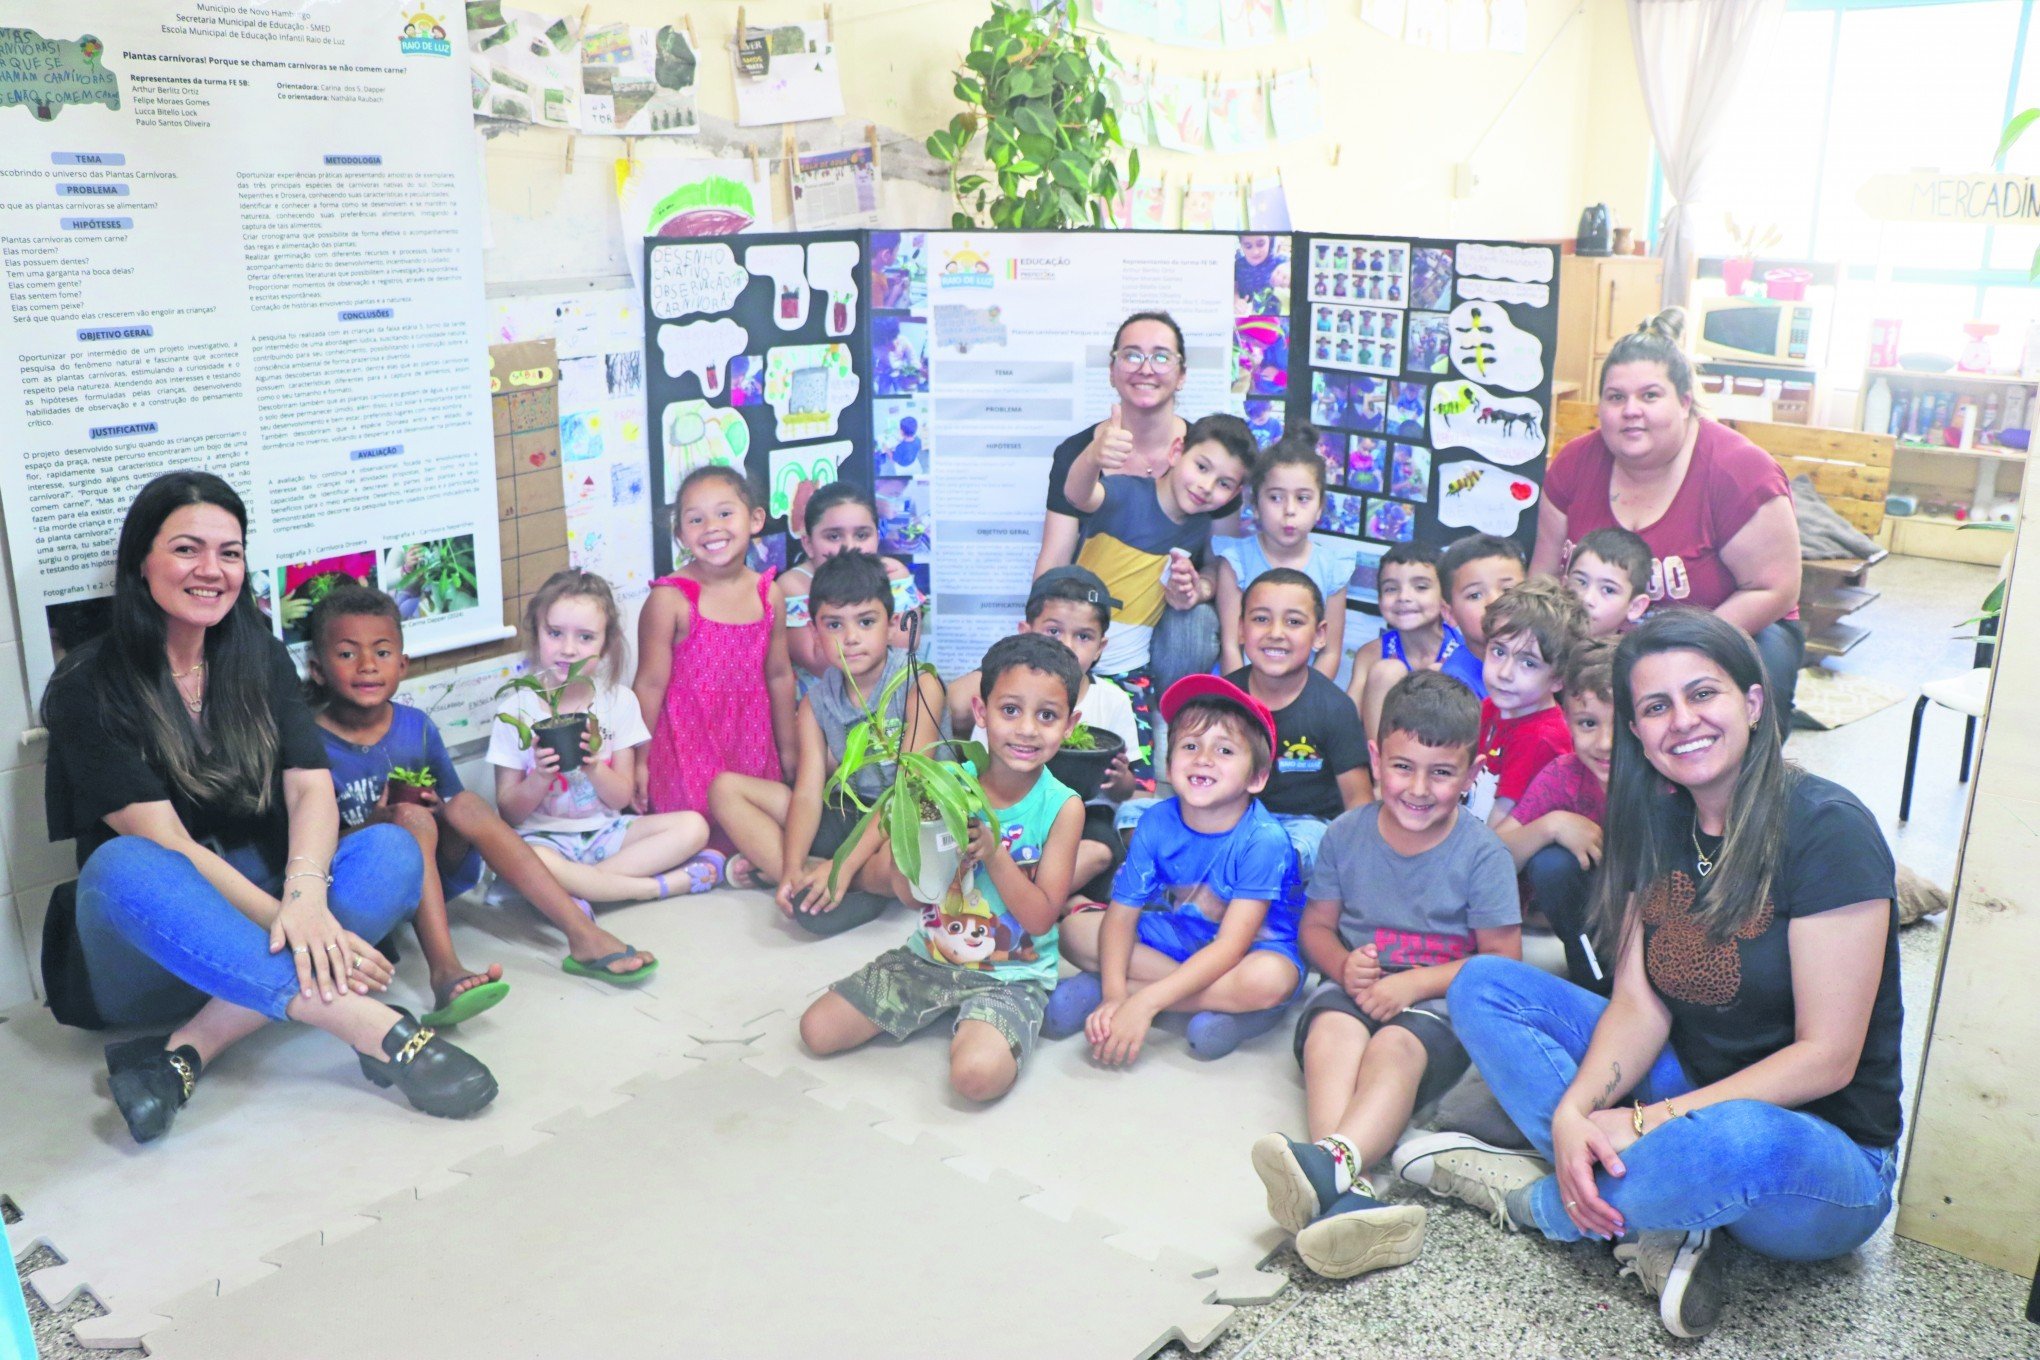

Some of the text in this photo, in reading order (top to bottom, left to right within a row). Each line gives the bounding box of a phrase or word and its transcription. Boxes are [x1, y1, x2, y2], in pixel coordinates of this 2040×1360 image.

[197, 4, 236, 15] Município
[237, 6, 248, 14] de
[249, 7, 270, 16] Novo
[176, 14, 216, 24] Secretaria
[218, 17, 256, 28] Municipal
[258, 20, 267, 28] de
[269, 21, 304, 32] Educação
[310, 24, 331, 32] SMED
[162, 25, 345, 45] Escola Municipal de Educação Infantil Raio de Luz
[402, 41, 420, 50] RAIO
[434, 44, 450, 52] LUZ
[10, 57, 41, 70] QUE
[45, 58, 64, 70] SE
[123, 51, 156, 61] Plantas
[158, 54, 206, 63] carnívoras!
[208, 56, 238, 66] Porque
[252, 58, 286, 67] chamam
[288, 60, 327, 70] carnívoras
[339, 62, 353, 71] não
[384, 66, 407, 74] carne?
[130, 74, 191, 84] Representantes
[204, 77, 227, 85] turma
[132, 85, 199, 95] Arthur Berlitz Ortiz
[134, 96, 210, 106] Felipe Moraes Gomes
[135, 107, 198, 117] Lucca Bitello Lock
[136, 118, 210, 128] Paulo Santos Oliveira
[76, 155, 101, 163] TEMA
[52, 170, 87, 178] universo
[89, 170, 103, 178] das
[105, 170, 134, 178] Plantas
[135, 170, 178, 178] Carnívoras.
[7, 203, 22, 211] que
[36, 201, 64, 211] plantas
[65, 201, 106, 209] carnívoras
[116, 201, 158, 209] alimentam?
[72, 219, 122, 228] HIPÓTESES
[1, 235, 31, 243] Plantas
[32, 234, 72, 243] carnívoras
[104, 234, 128, 242] carne?
[3, 246, 58, 255] Elas mordem?
[653, 248, 725, 265] DESENHO
[1020, 256, 1070, 266] EDUCAÇÃO
[5, 257, 89, 268] Elas possuem dentes?
[6, 269, 24, 277] Tem
[46, 268, 79, 278] garganta
[92, 267, 110, 275] boca
[111, 266, 135, 275] delas?
[8, 281, 24, 289] Elas
[57, 279, 82, 289] gente?
[10, 290, 82, 300] Elas sentem fome?
[12, 303, 28, 312] Elas
[60, 301, 84, 312] peixe?
[13, 314, 31, 323] Será
[33, 315, 48, 324] que
[50, 312, 79, 323] quando
[81, 311, 96, 319] elas
[136, 308, 149, 317] vão
[151, 307, 174, 318] engolir
[186, 305, 216, 315] crianças?
[342, 310, 389, 320] CONCLUSÕES
[80, 330, 150, 340] OBJETIVO GERAL
[92, 424, 156, 436] JUSTIFICATIVA
[358, 448, 397, 460] AVALIAÇÃO
[43, 585, 84, 597] Fotografias
